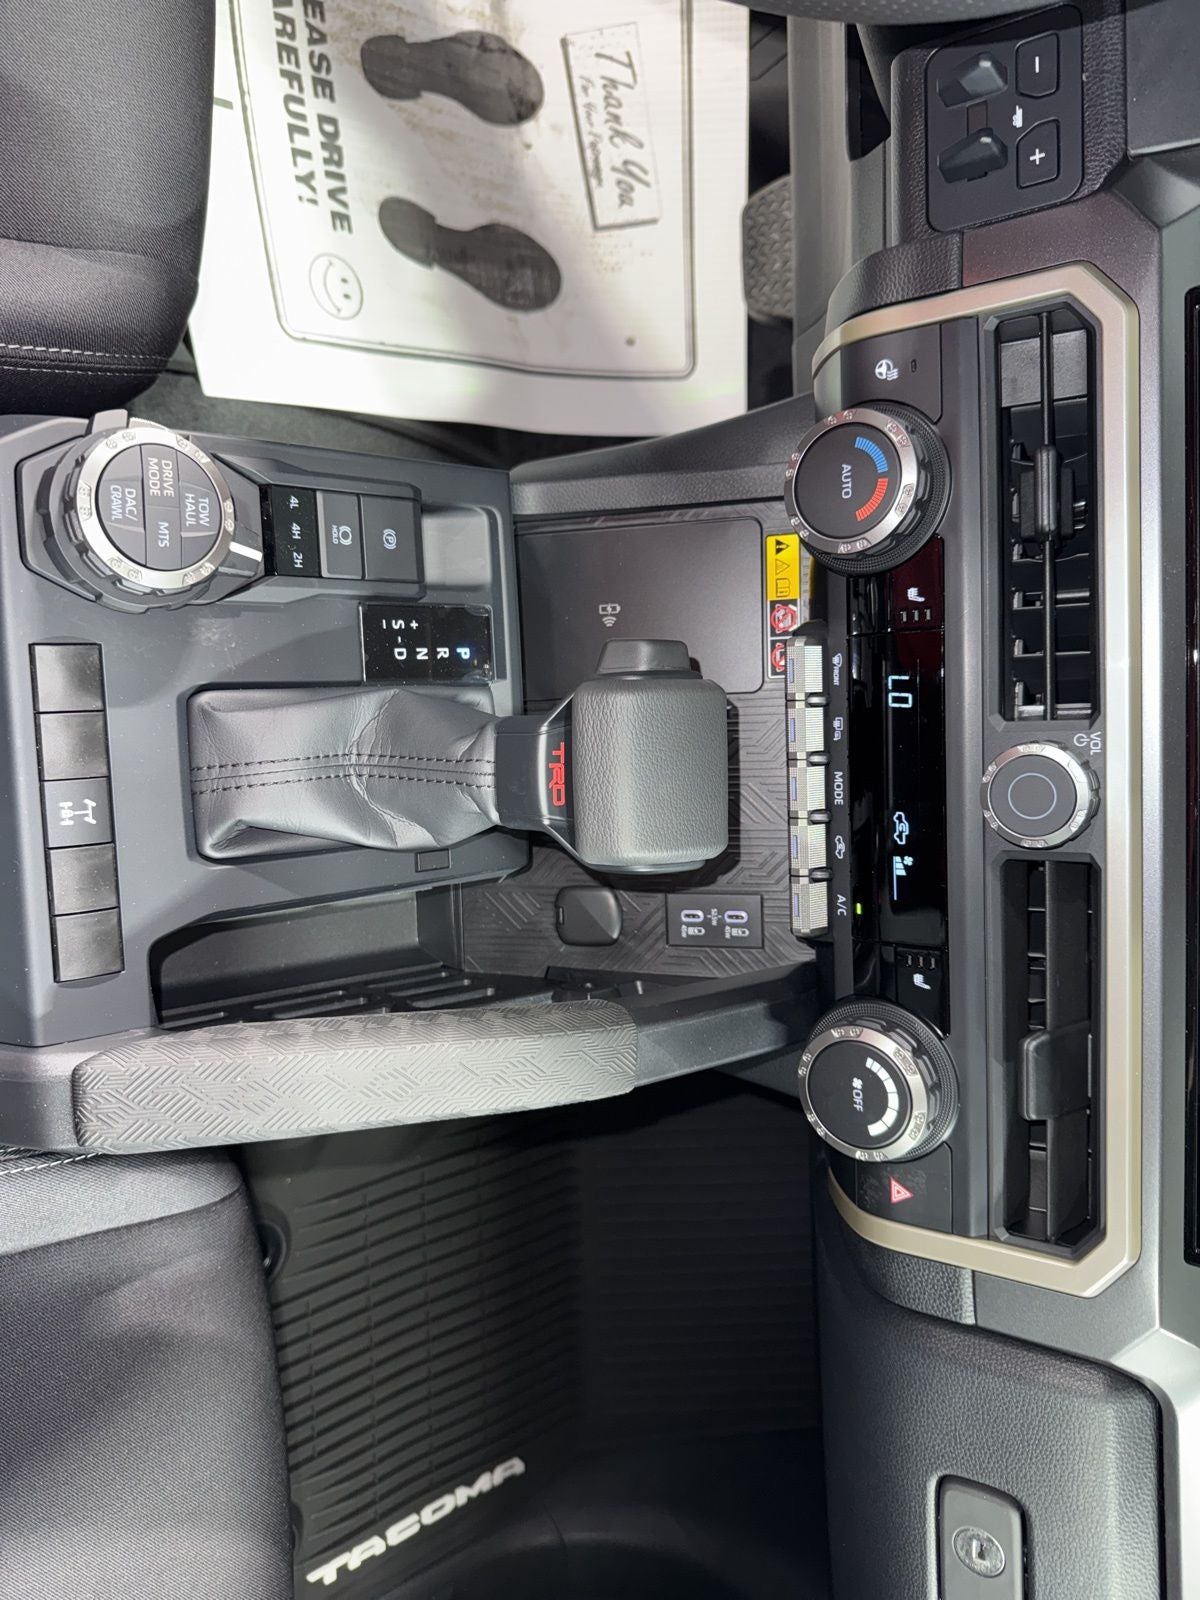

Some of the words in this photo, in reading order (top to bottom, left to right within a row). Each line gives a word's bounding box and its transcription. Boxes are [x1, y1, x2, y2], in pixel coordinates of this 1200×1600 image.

[594, 50, 645, 150] Thank
[316, 113, 353, 235] DRIVE
[610, 159, 651, 209] You
[147, 457, 161, 497] MODE
[161, 459, 175, 498] DRIVE
[841, 463, 852, 499] AUTO
[110, 484, 122, 520] CRAWL
[124, 487, 139, 521] DAC/
[184, 493, 196, 527] HAUL
[198, 496, 210, 527] TOW
[289, 495, 299, 510] 4L
[157, 521, 170, 549] MTS
[290, 522, 302, 540] 4H
[331, 524, 339, 545] HOLD
[292, 551, 303, 569] 2H
[416, 647, 429, 660] N
[436, 647, 450, 660] R
[456, 647, 471, 660] P
[888, 675, 913, 708] LO
[1089, 731, 1102, 756] VOL
[548, 741, 566, 806] TRD
[833, 771, 844, 806] MODE
[837, 894, 847, 917] A/C
[852, 1089, 864, 1112] OFF
[306, 1456, 526, 1586] TACOMA
